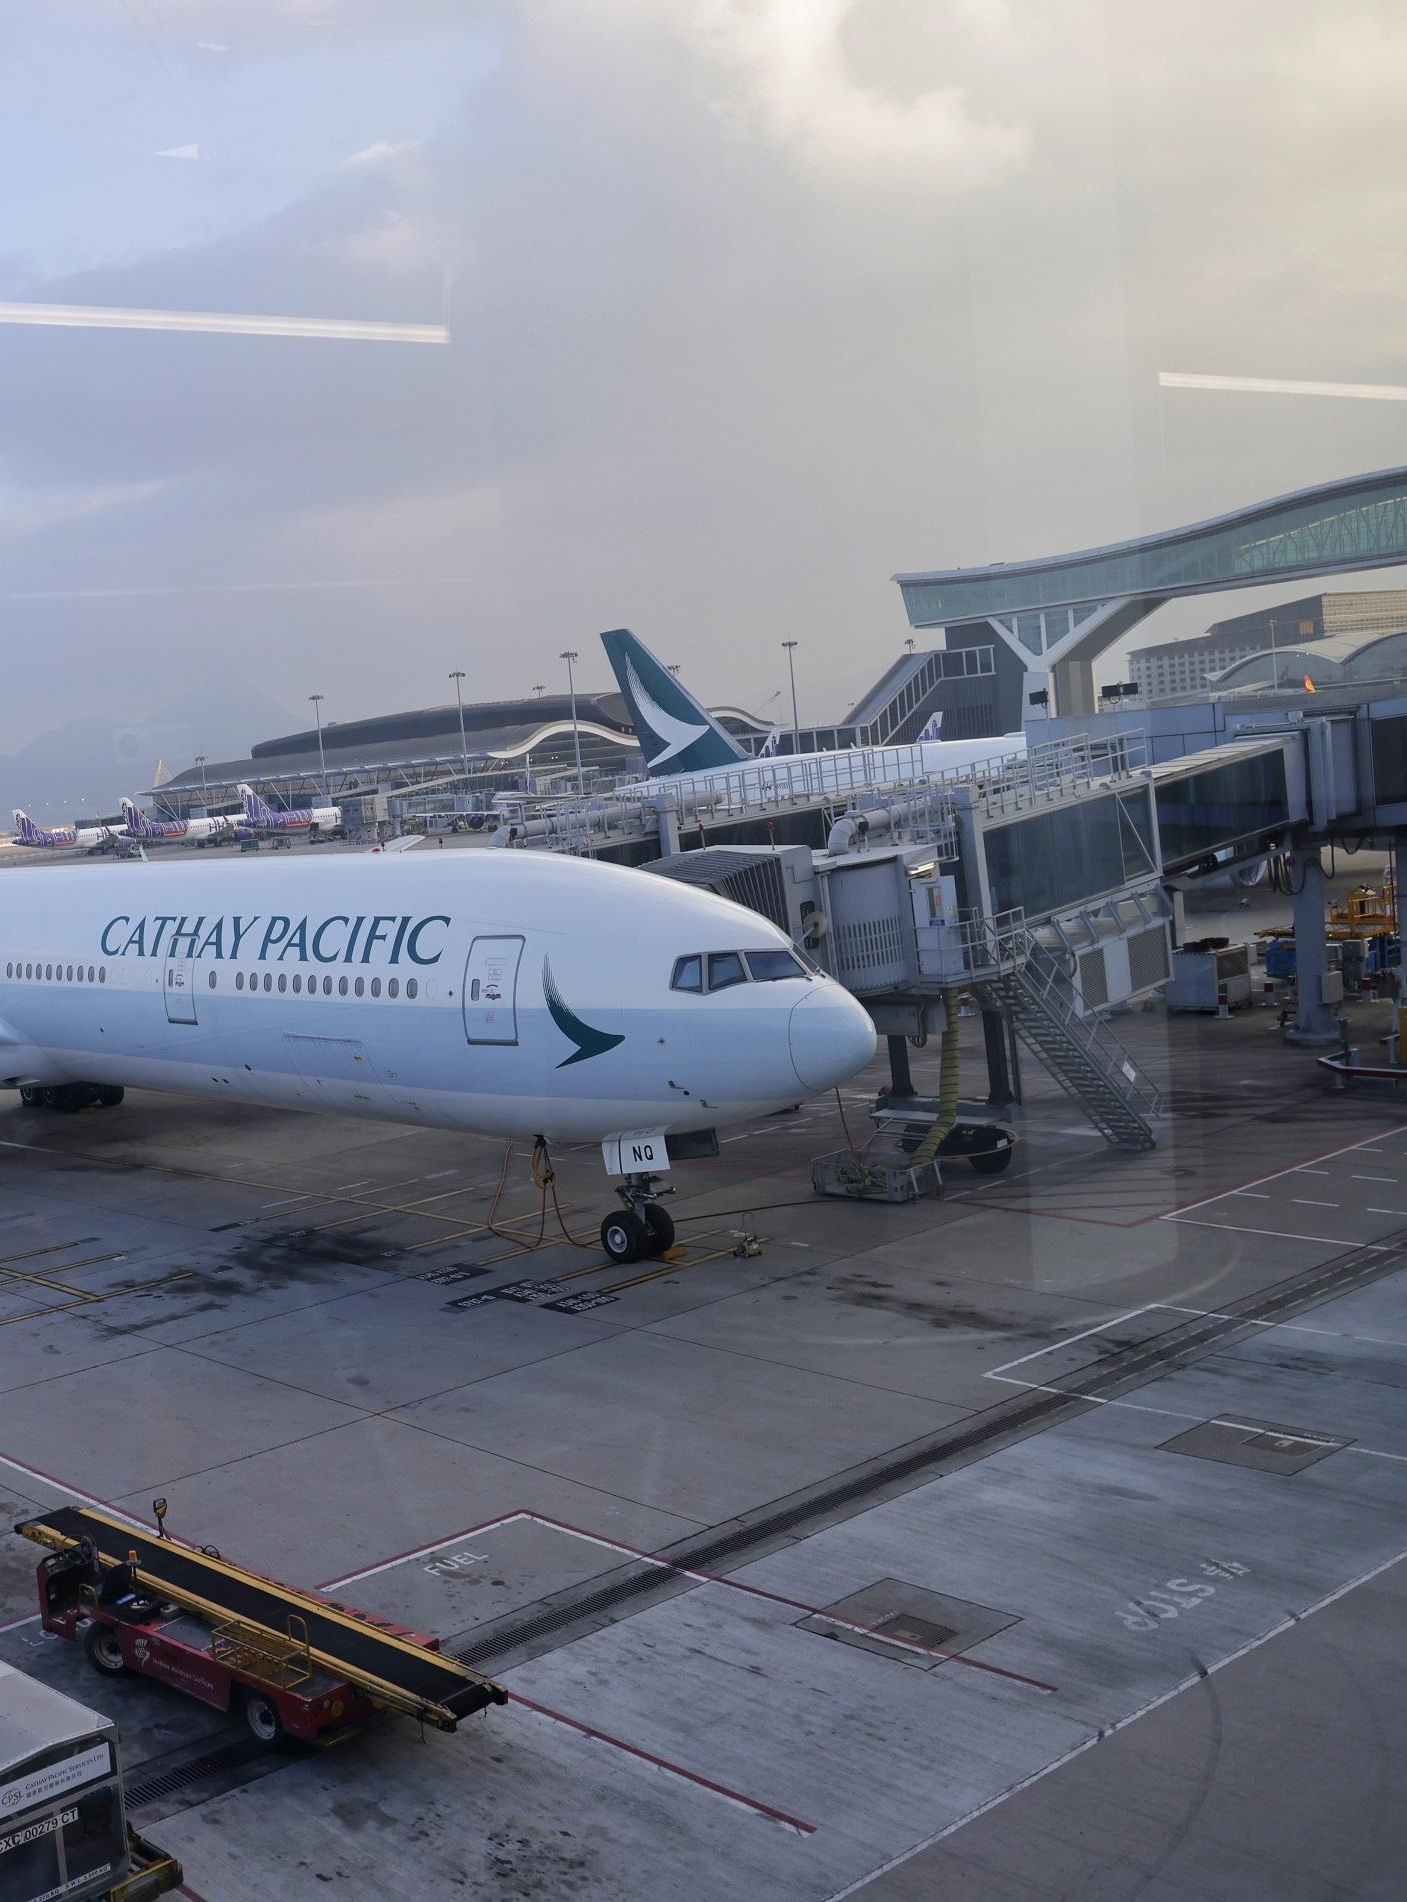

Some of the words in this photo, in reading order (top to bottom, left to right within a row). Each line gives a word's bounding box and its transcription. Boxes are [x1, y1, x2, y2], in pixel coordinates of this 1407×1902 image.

[101, 915, 259, 961] CATHAY
[258, 915, 451, 965] PACIFIC
[632, 1144, 654, 1162] NQ
[422, 1552, 490, 1576] FUEL
[1114, 1578, 1216, 1631] STOP
[25, 1778, 48, 1790] CATHAY
[48, 1769, 68, 1781] PACIFIC
[69, 1759, 94, 1772] SERVICES
[93, 1753, 104, 1762] LTD
[1, 1789, 24, 1807] CPSL
[24, 1818, 59, 1841] 00279
[61, 1809, 77, 1824] CT
